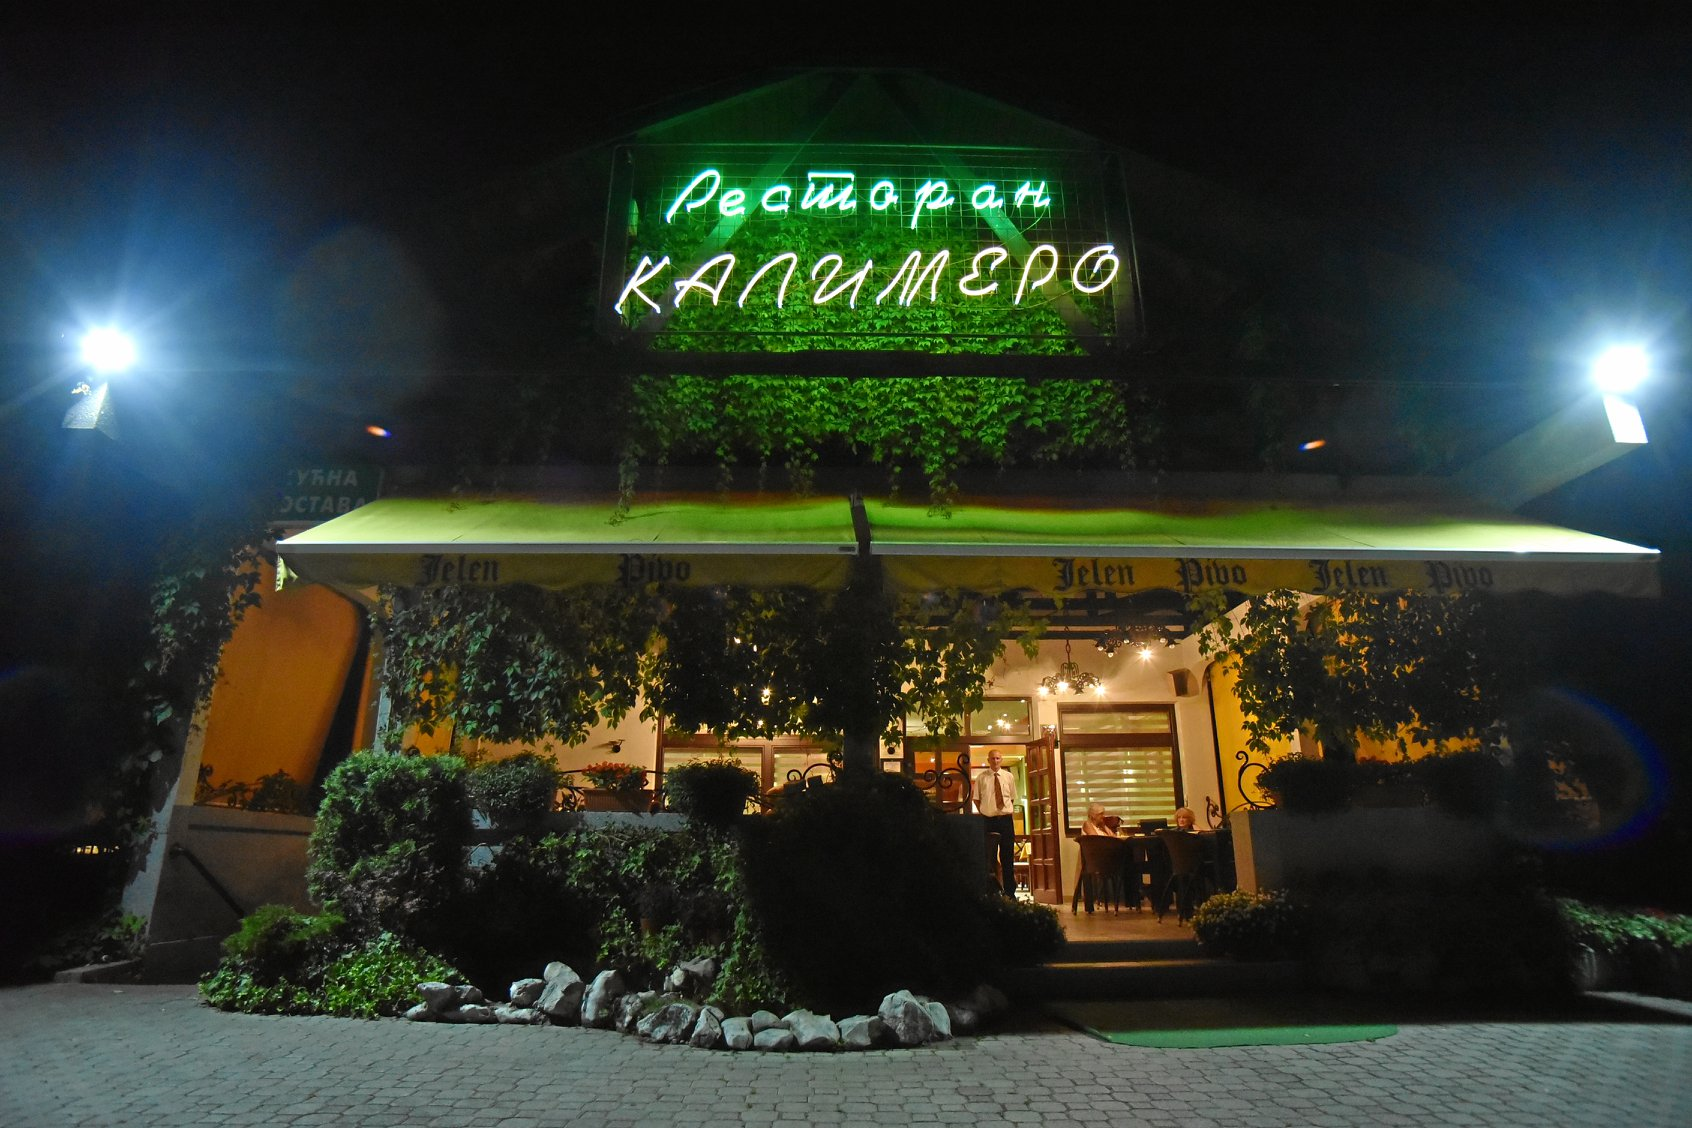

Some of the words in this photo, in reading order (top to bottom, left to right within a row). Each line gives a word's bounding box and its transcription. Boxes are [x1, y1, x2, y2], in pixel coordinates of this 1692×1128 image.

[665, 168, 1052, 230] Ресторан
[613, 244, 1121, 315] КАЛИМЕРО
[421, 554, 498, 584] Jelen
[618, 554, 691, 586] Pivo
[1053, 558, 1135, 591] Jelen
[1175, 558, 1247, 593] Pivo
[1308, 559, 1387, 593] Jelen
[1424, 560, 1493, 594] Pivo
